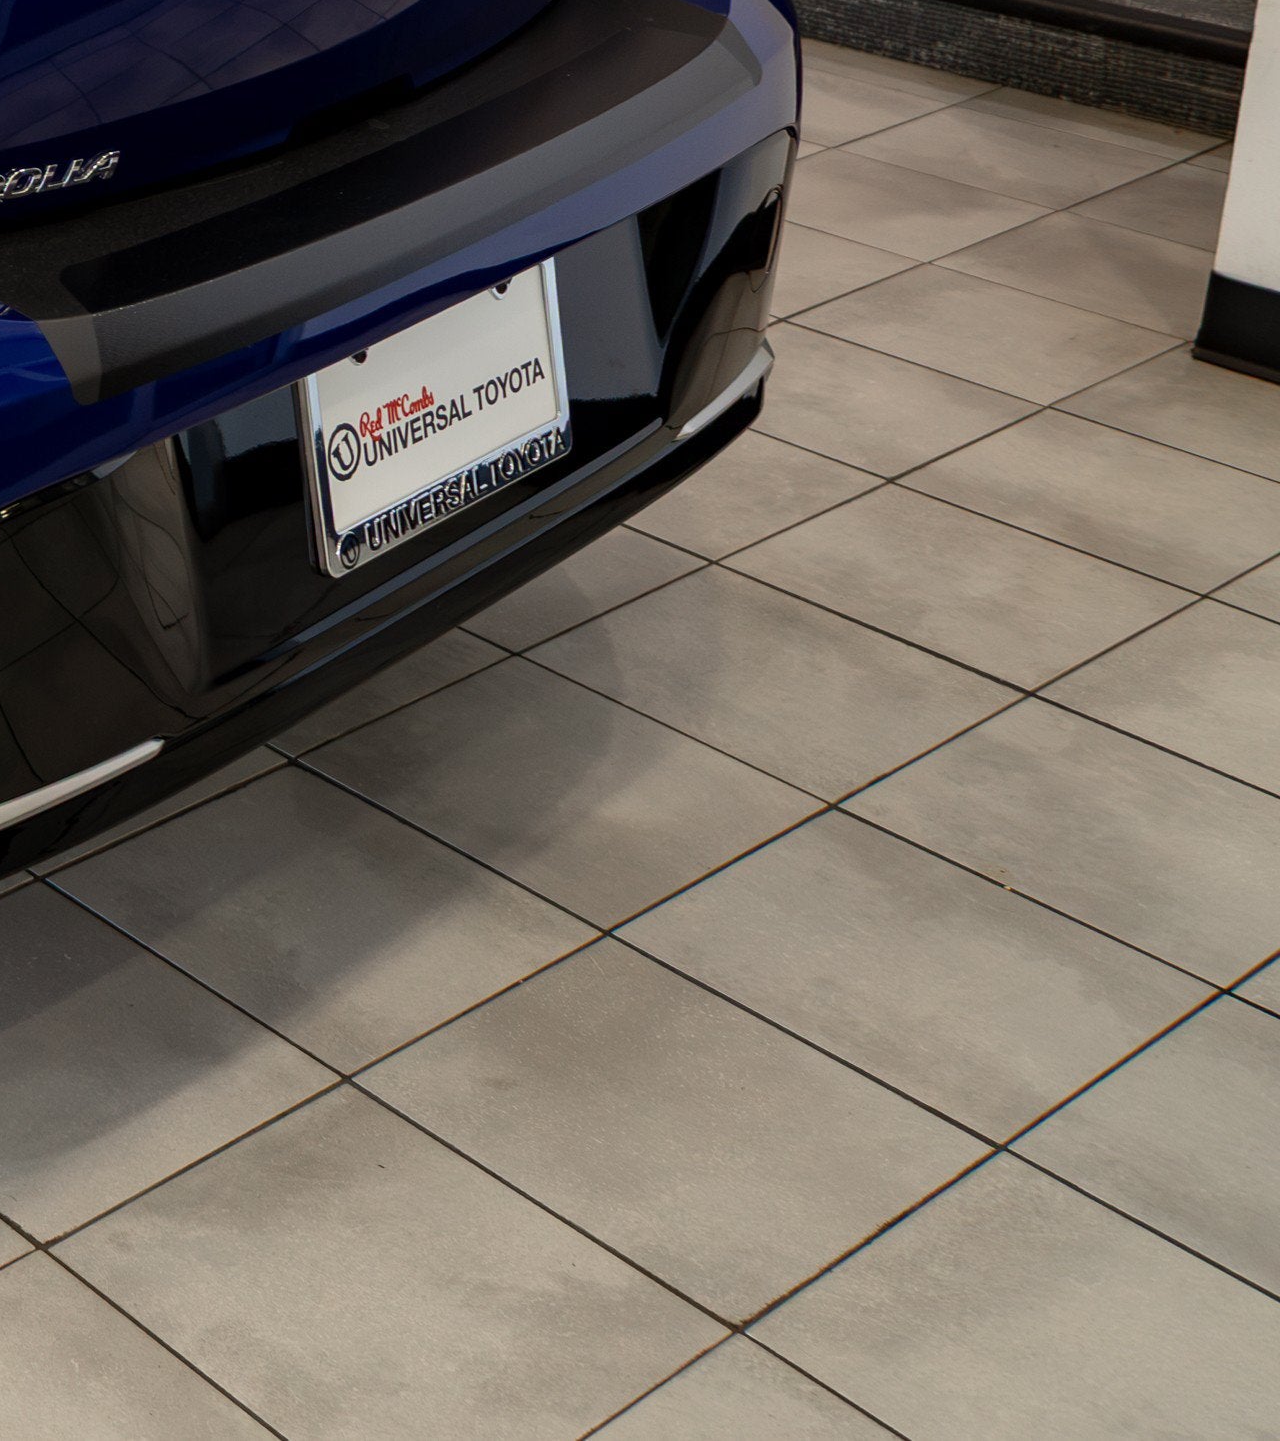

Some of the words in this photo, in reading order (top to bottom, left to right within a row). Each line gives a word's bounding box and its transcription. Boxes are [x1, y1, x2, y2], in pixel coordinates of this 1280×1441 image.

[359, 406, 382, 442] Red
[363, 394, 472, 467] UNIVERSAL
[473, 357, 546, 411] TOYOTA
[364, 465, 488, 551] UNIVERSAL
[490, 426, 567, 487] TOYOTA
